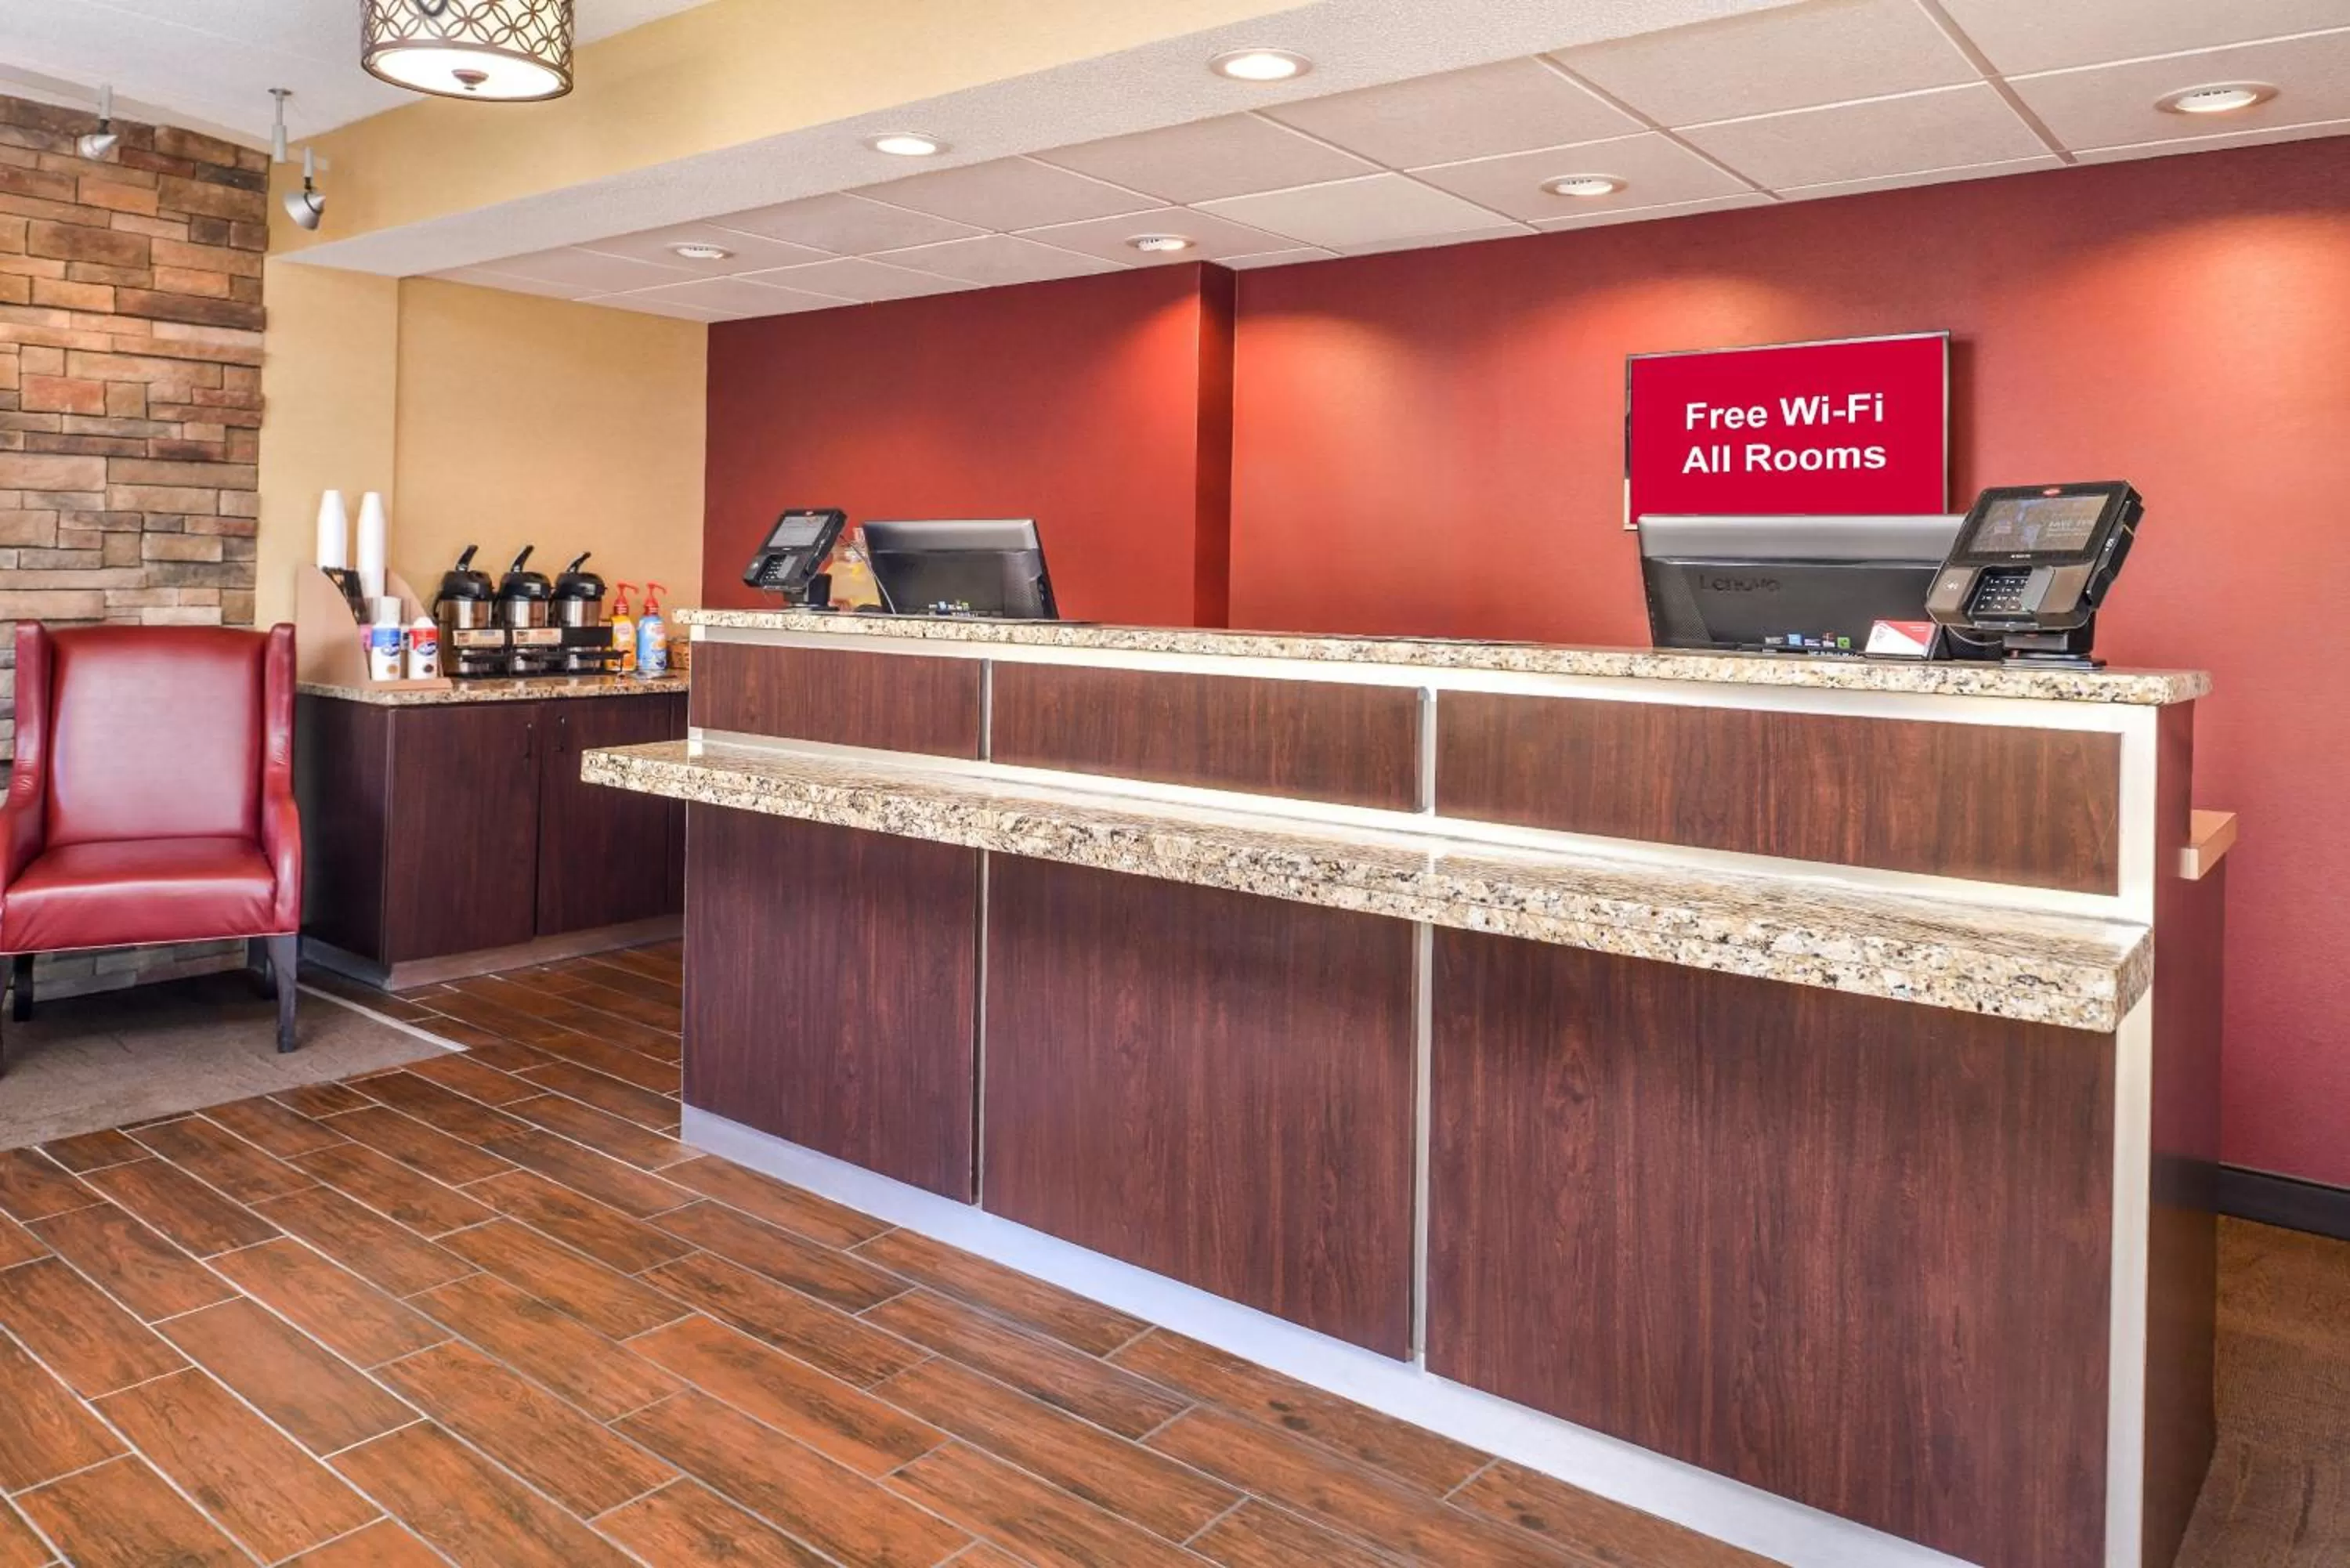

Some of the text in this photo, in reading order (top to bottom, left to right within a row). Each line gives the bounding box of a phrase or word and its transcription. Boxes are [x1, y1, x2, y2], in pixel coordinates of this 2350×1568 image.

[1686, 392, 1883, 430] Free Wi-Fi
[1682, 443, 1887, 473] All Rooms
